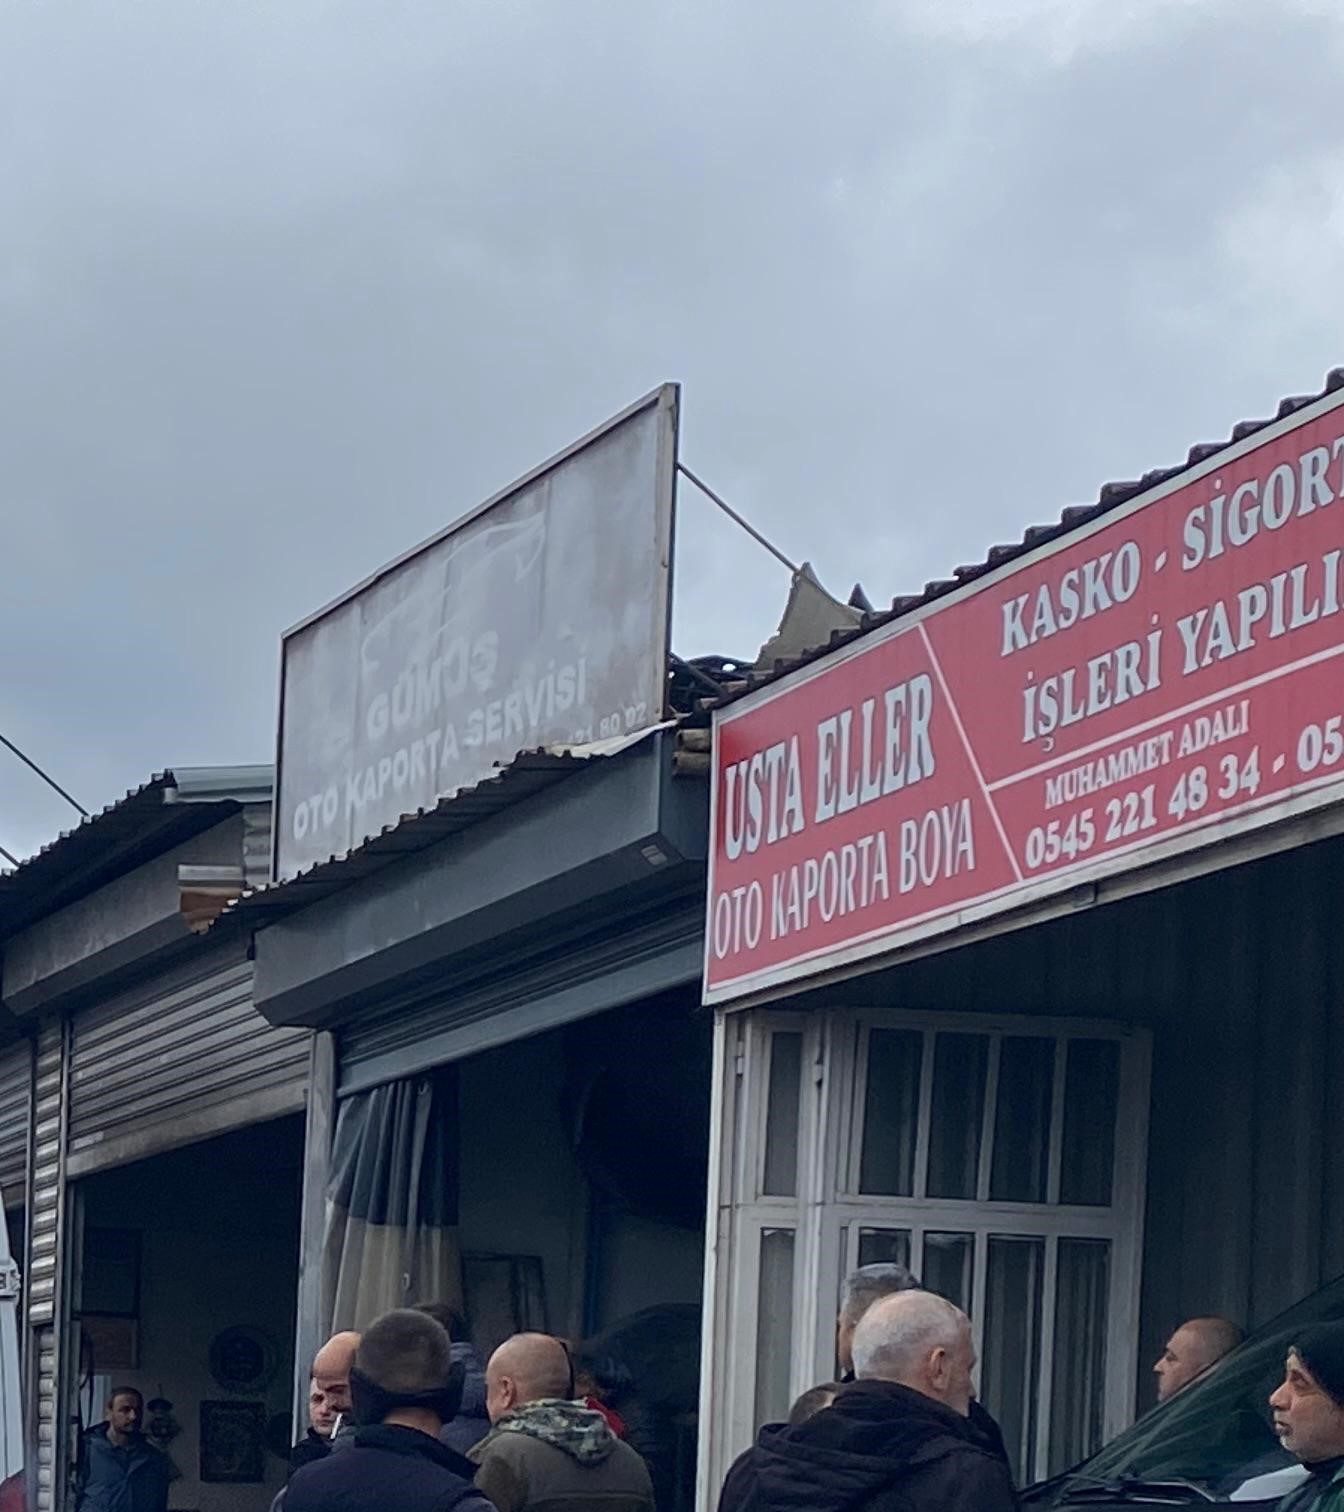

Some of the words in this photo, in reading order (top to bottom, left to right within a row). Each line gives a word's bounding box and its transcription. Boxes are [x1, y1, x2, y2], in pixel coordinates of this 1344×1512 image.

[1001, 541, 1141, 657] KASKO
[1022, 613, 1163, 752] İŞLERİ
[1178, 548, 1344, 676] YAPILI
[293, 785, 339, 841] OTO
[344, 723, 460, 820] KAPORTA
[724, 735, 805, 860] USTA
[815, 673, 935, 824] ELLER
[1025, 807, 1095, 869] 0545
[1105, 784, 1157, 842] 221
[1168, 766, 1208, 821] 48
[1218, 745, 1261, 800] 34
[1045, 731, 1174, 810] MUHAMMET
[1177, 699, 1250, 759] ADALI
[714, 880, 762, 960] OTO
[770, 830, 890, 940] KAPORTA
[899, 798, 975, 894] BOYA
